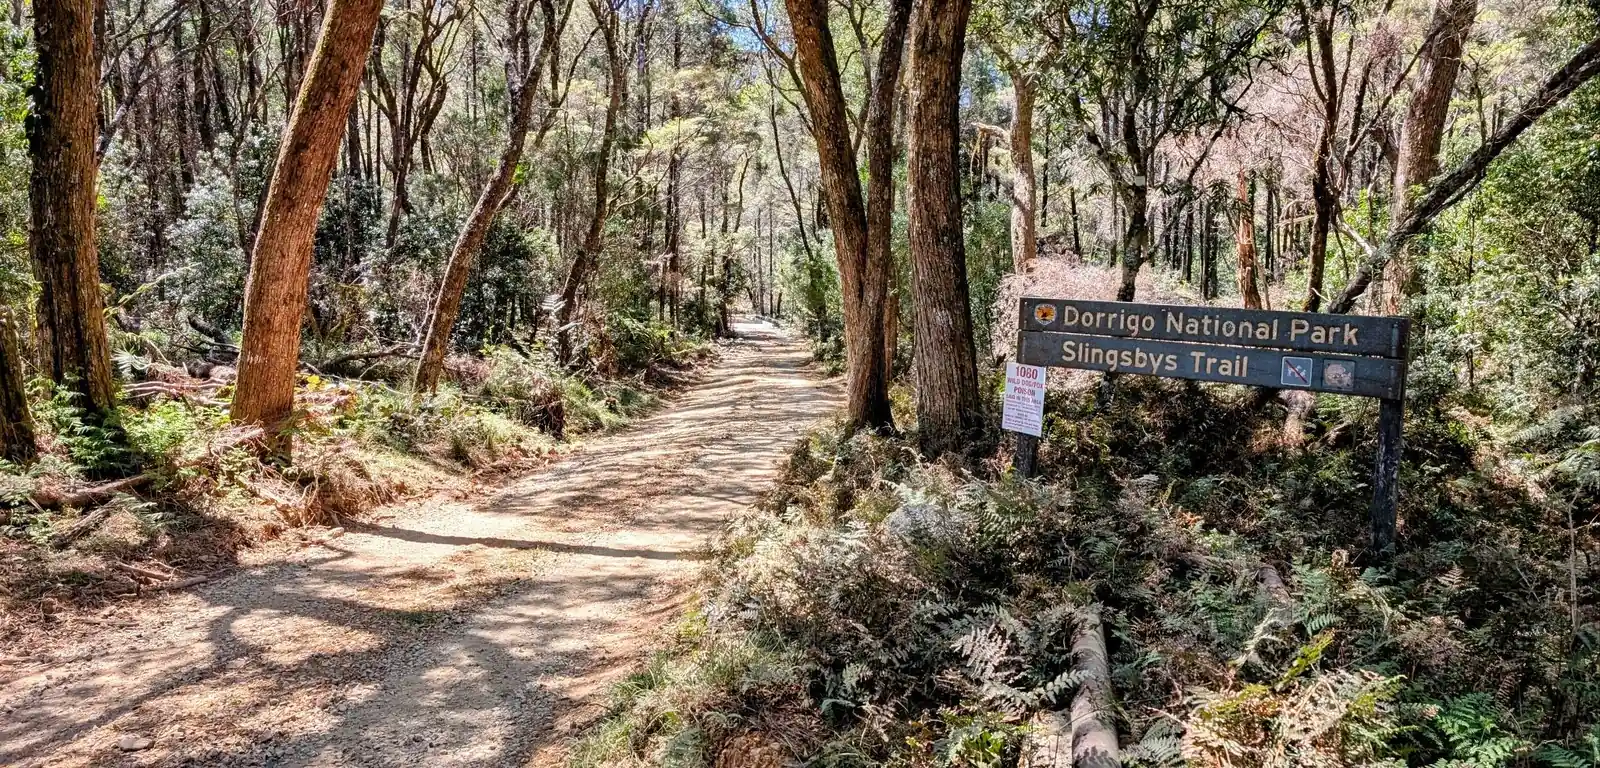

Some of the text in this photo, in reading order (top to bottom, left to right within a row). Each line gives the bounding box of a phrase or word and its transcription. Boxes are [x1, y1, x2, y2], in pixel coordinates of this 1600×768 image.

[1065, 306, 1155, 336] Dorrigo
[1166, 312, 1277, 340] National
[1290, 319, 1358, 346] Park
[1062, 341, 1249, 378] Slingsbys Trail
[1016, 366, 1038, 380] 1080
[1013, 386, 1035, 396] POISON
